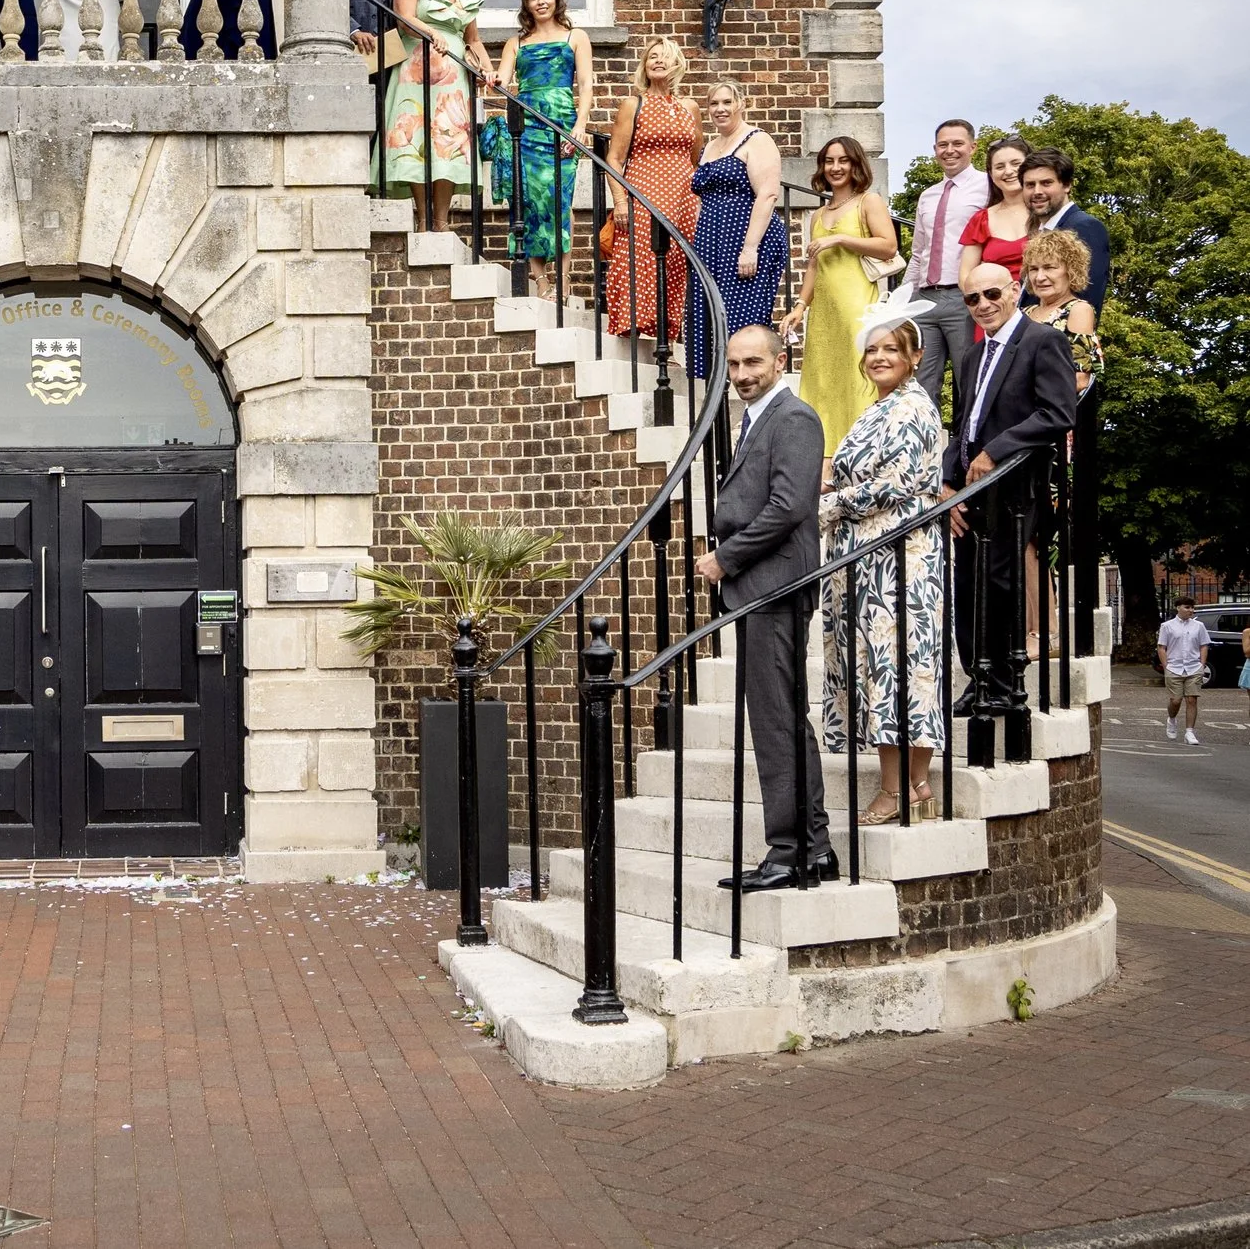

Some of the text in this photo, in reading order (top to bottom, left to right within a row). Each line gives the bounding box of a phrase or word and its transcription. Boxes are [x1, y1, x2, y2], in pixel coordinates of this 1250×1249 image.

[1, 300, 62, 325] Office
[71, 299, 86, 318] &
[92, 304, 178, 366] Ceremony
[176, 364, 213, 430] Rooms
